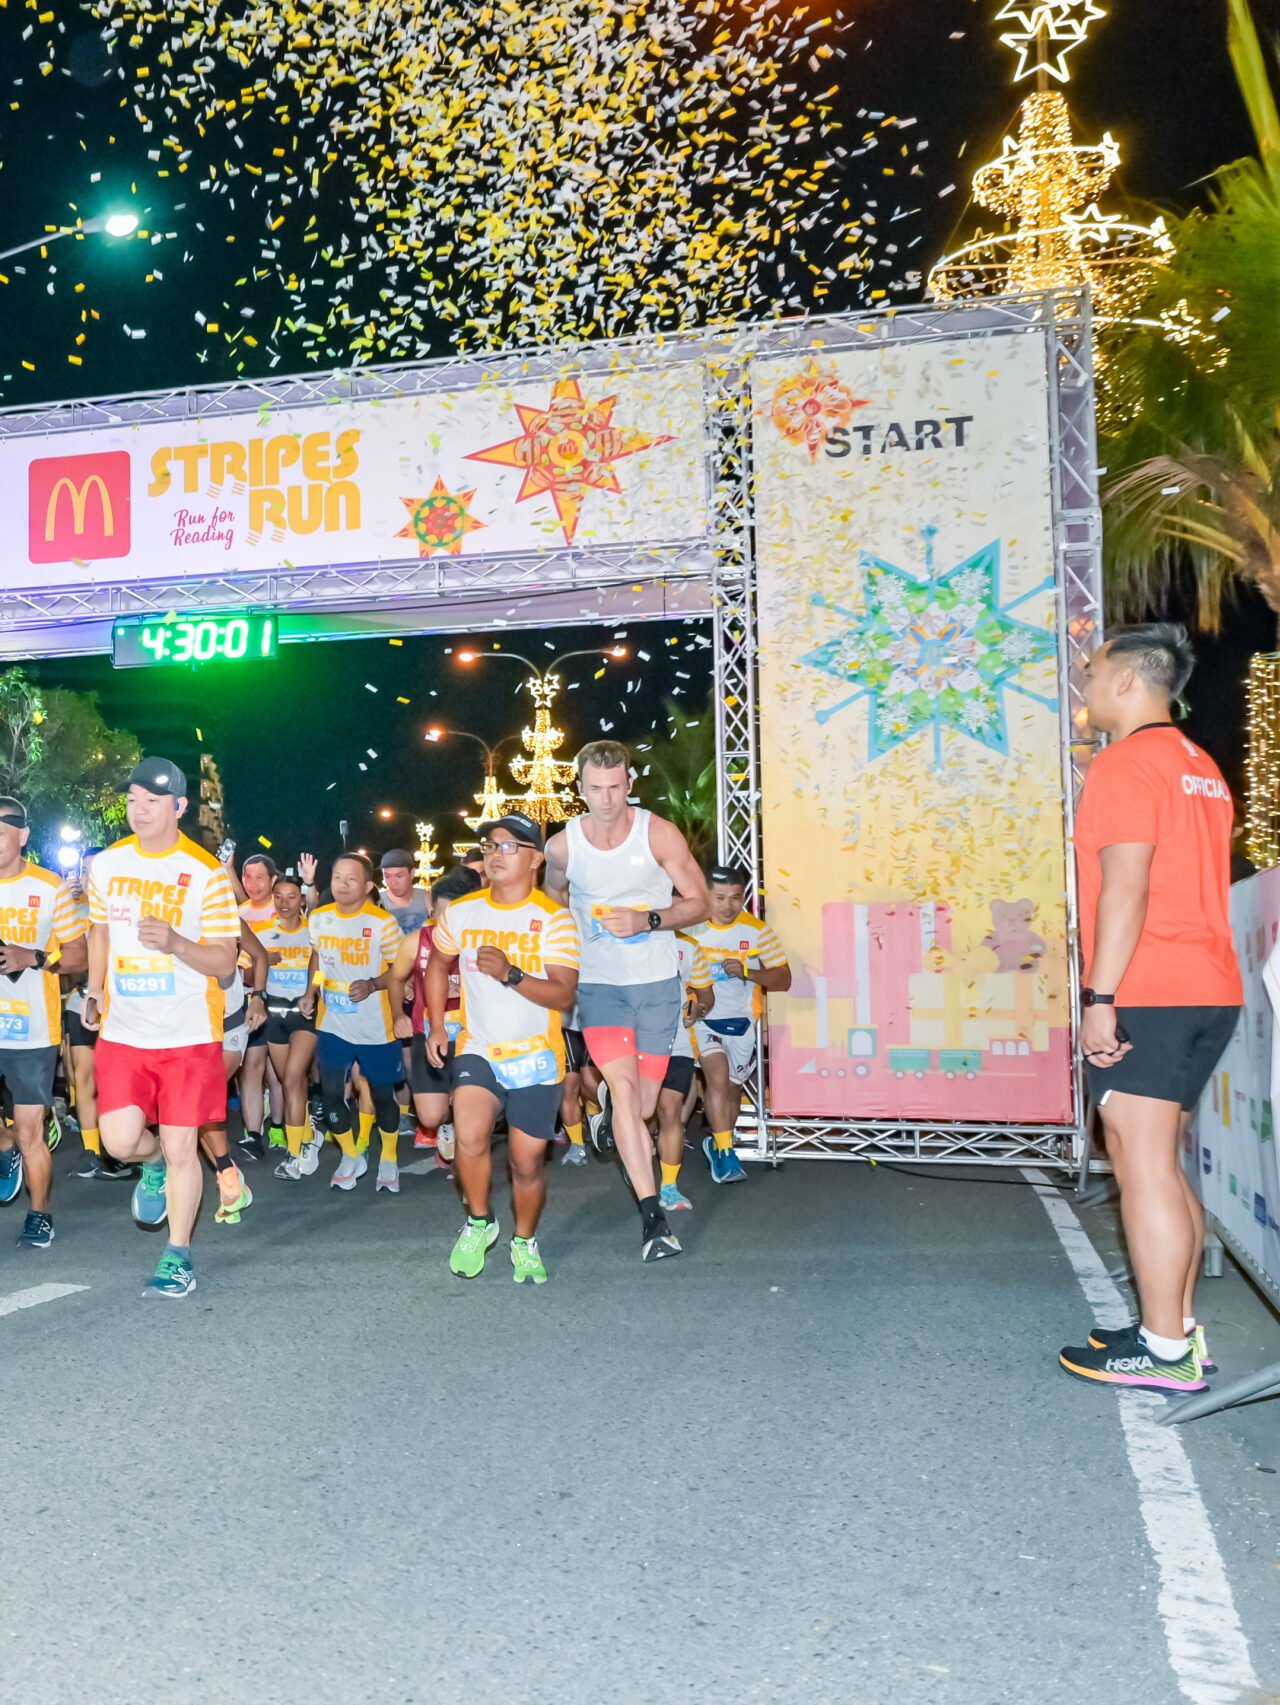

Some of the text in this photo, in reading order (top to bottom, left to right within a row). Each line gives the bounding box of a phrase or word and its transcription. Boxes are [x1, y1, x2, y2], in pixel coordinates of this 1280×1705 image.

[825, 415, 974, 459] START
[147, 429, 361, 498] STRIPES
[174, 506, 235, 530] Run for
[245, 480, 362, 546] RUN
[170, 527, 235, 550] Reading
[141, 619, 272, 661] 4:30:01
[1181, 774, 1230, 802] OFFICIA
[107, 875, 188, 906] STRIPES
[140, 900, 183, 927] RUN
[0, 926, 38, 944] RUN
[317, 936, 371, 952] STRIPES
[461, 929, 541, 953] STRIPES
[341, 951, 370, 966] RUN
[507, 953, 541, 974] UN
[119, 977, 167, 992] 16291
[273, 971, 306, 980] 15773
[498, 1056, 548, 1077] 15715
[1105, 1355, 1154, 1372] HOKA
